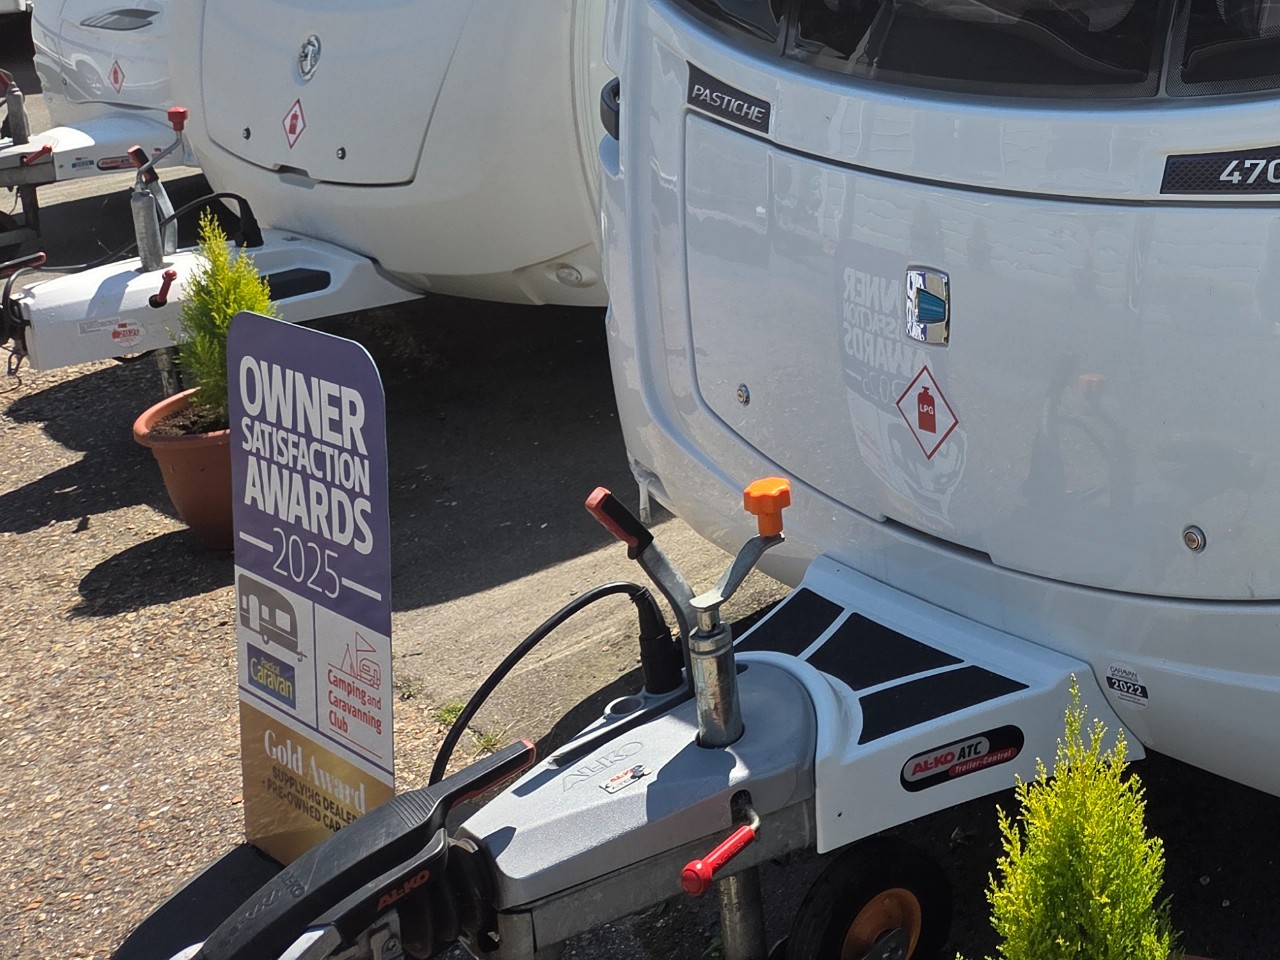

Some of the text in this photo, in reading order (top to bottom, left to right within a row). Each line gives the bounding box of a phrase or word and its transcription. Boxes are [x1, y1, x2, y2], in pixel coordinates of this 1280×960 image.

[691, 84, 766, 123] PASTICHE
[239, 355, 368, 456] OWNER
[919, 403, 935, 415] LPG
[241, 416, 370, 497] SATISFACTION
[244, 455, 374, 556] AWARDS
[272, 527, 340, 600] 2025
[250, 657, 293, 701] Caravan
[327, 668, 382, 711] Camping and
[1111, 678, 1144, 697] 2022
[328, 689, 382, 735] Caravanning
[329, 709, 349, 734] Club
[264, 729, 367, 815] Gold Award
[910, 740, 983, 777] AL-KO ATC
[954, 749, 1012, 775] Trailer-Control
[267, 778, 321, 823] PRE-OWNED
[272, 765, 321, 808] SUPPLYING
